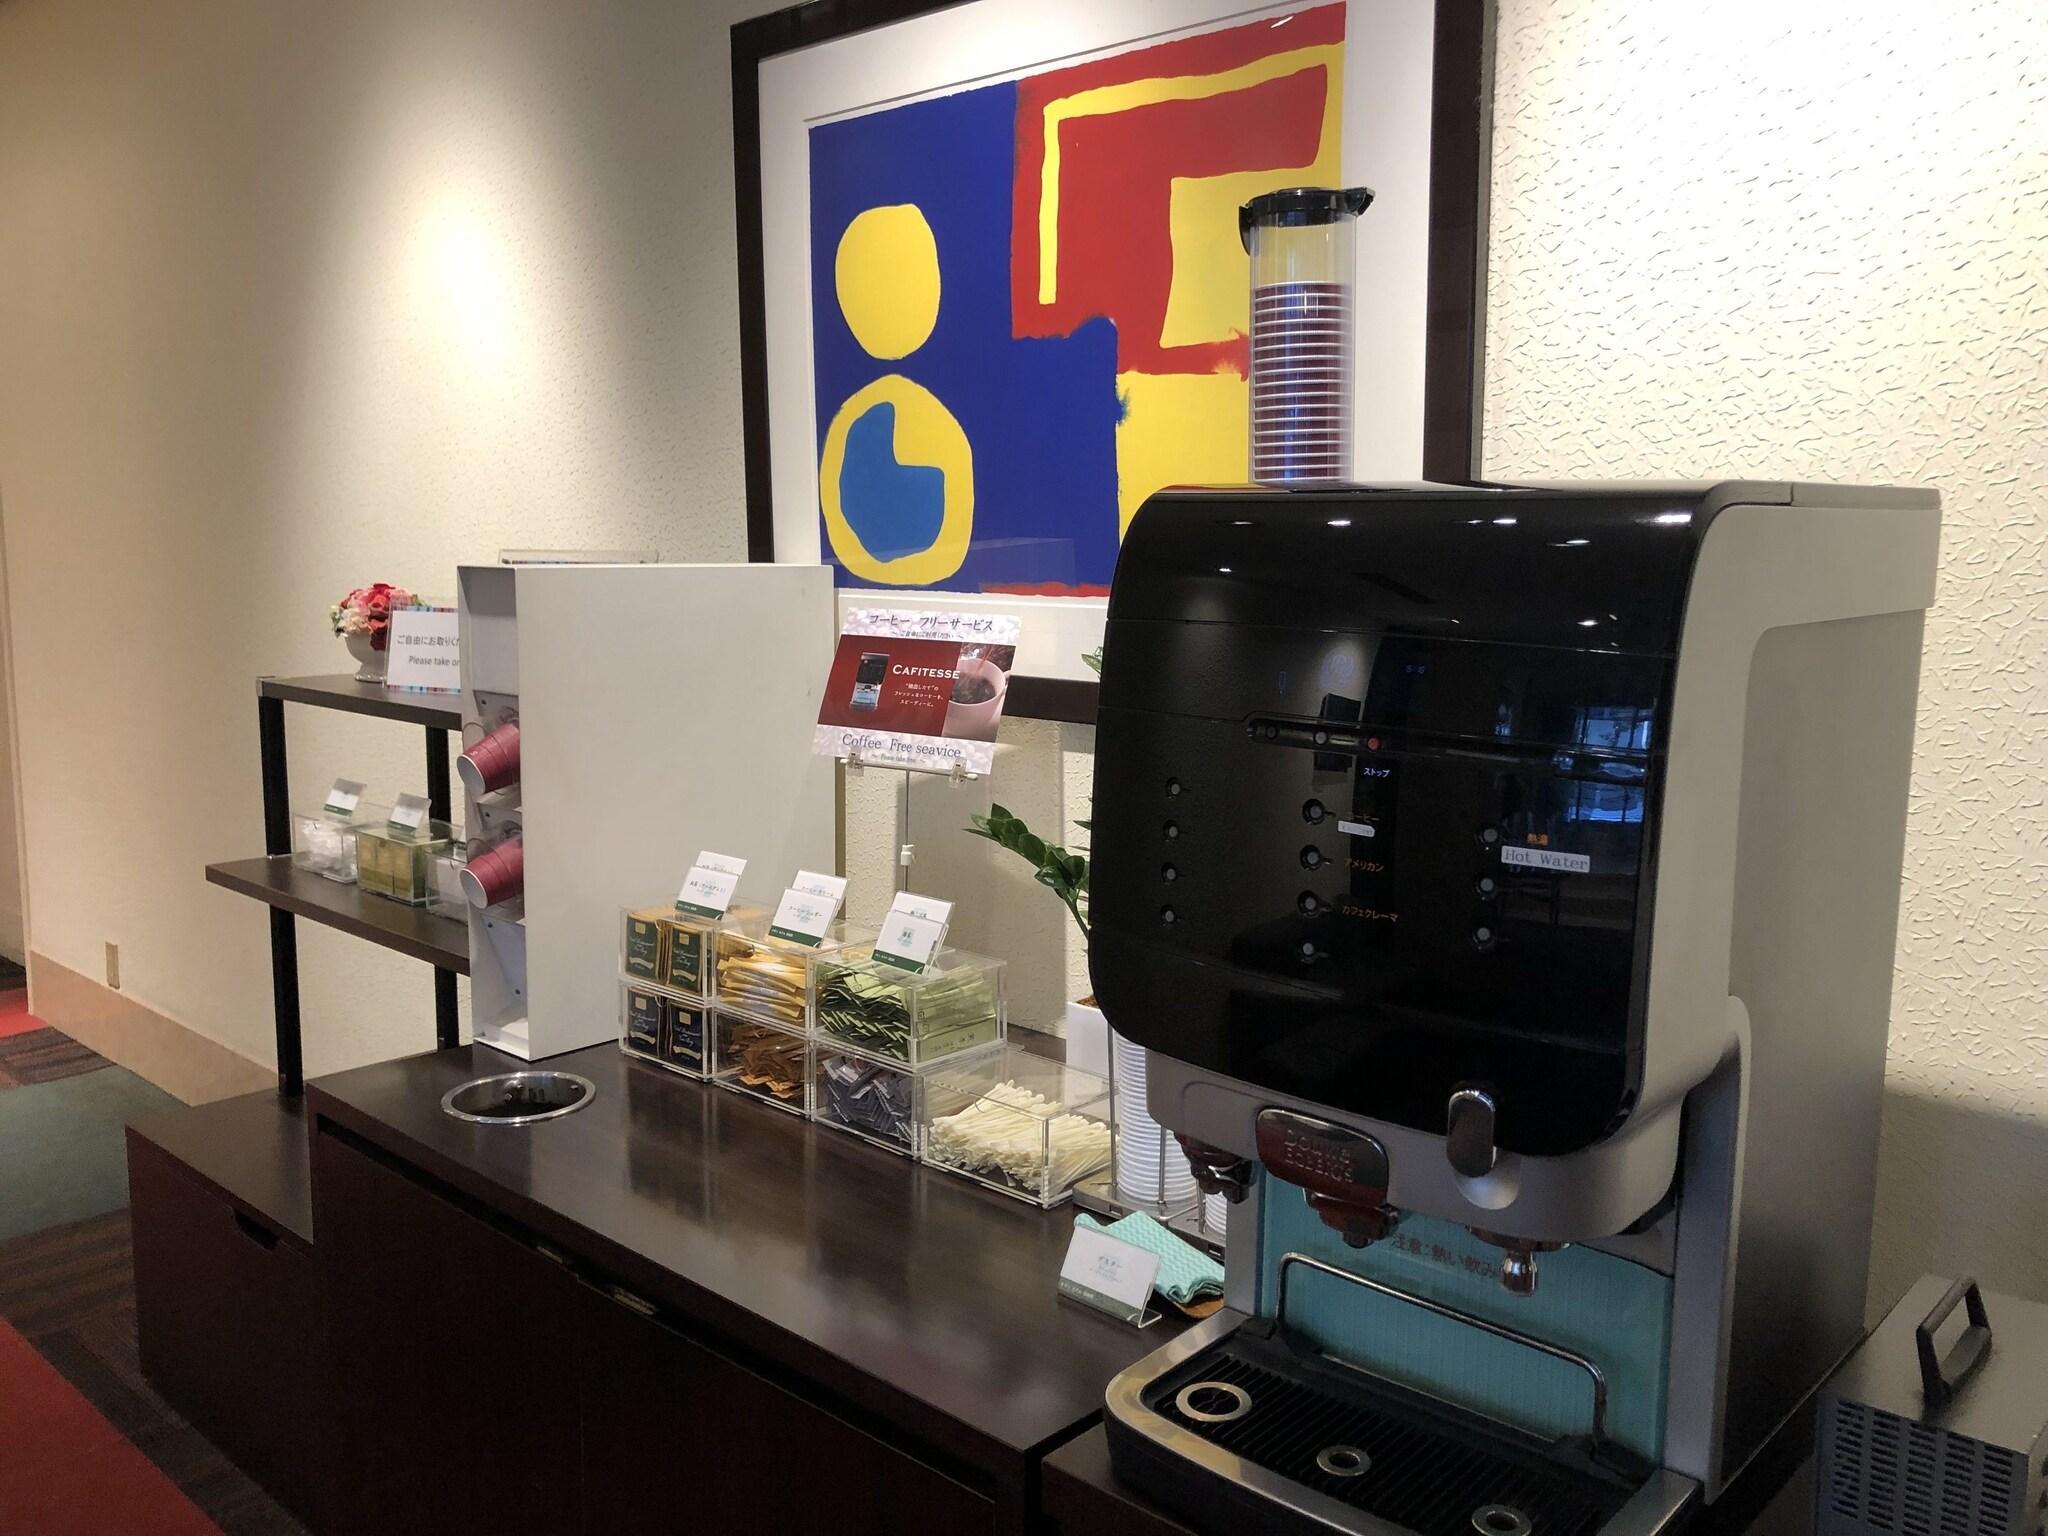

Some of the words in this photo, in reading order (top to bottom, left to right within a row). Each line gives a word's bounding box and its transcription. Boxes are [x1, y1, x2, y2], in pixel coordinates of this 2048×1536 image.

[870, 615, 911, 626] コーヒー
[920, 616, 993, 631] フリーサービス
[408, 655, 432, 665] Please
[434, 656, 450, 666] take
[892, 664, 961, 680] CAFITESSE
[842, 733, 882, 749] Coffee
[889, 738, 912, 753] Free
[915, 744, 961, 758] seavice
[1363, 767, 1390, 778] ストップ
[1344, 858, 1385, 872] アメリカン
[1505, 849, 1531, 863] Hot
[1539, 854, 1588, 869] Water
[1342, 905, 1399, 922] カフェクレーマ
